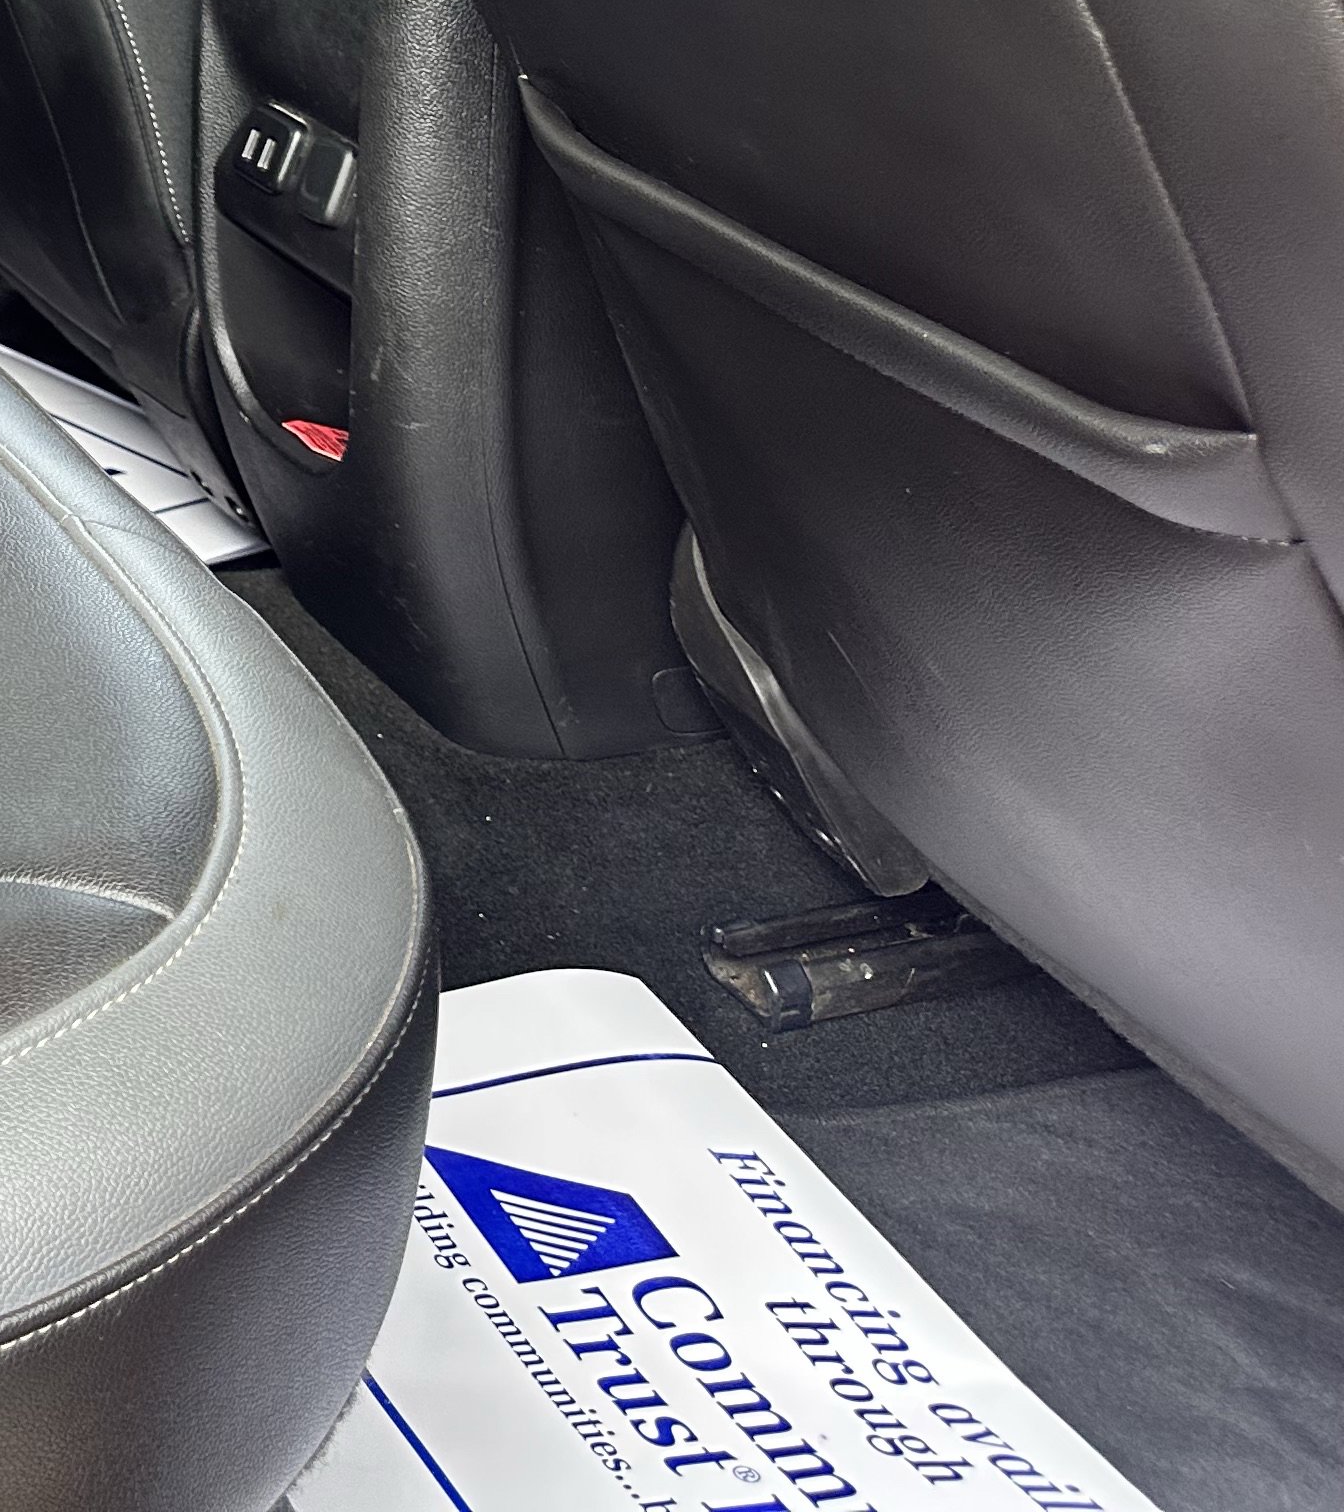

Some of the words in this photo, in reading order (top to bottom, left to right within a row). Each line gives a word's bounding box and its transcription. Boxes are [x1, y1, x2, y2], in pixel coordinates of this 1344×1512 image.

[707, 1147, 941, 1386] Financing
[632, 1276, 878, 1512] Comm
[765, 1297, 974, 1486] through
